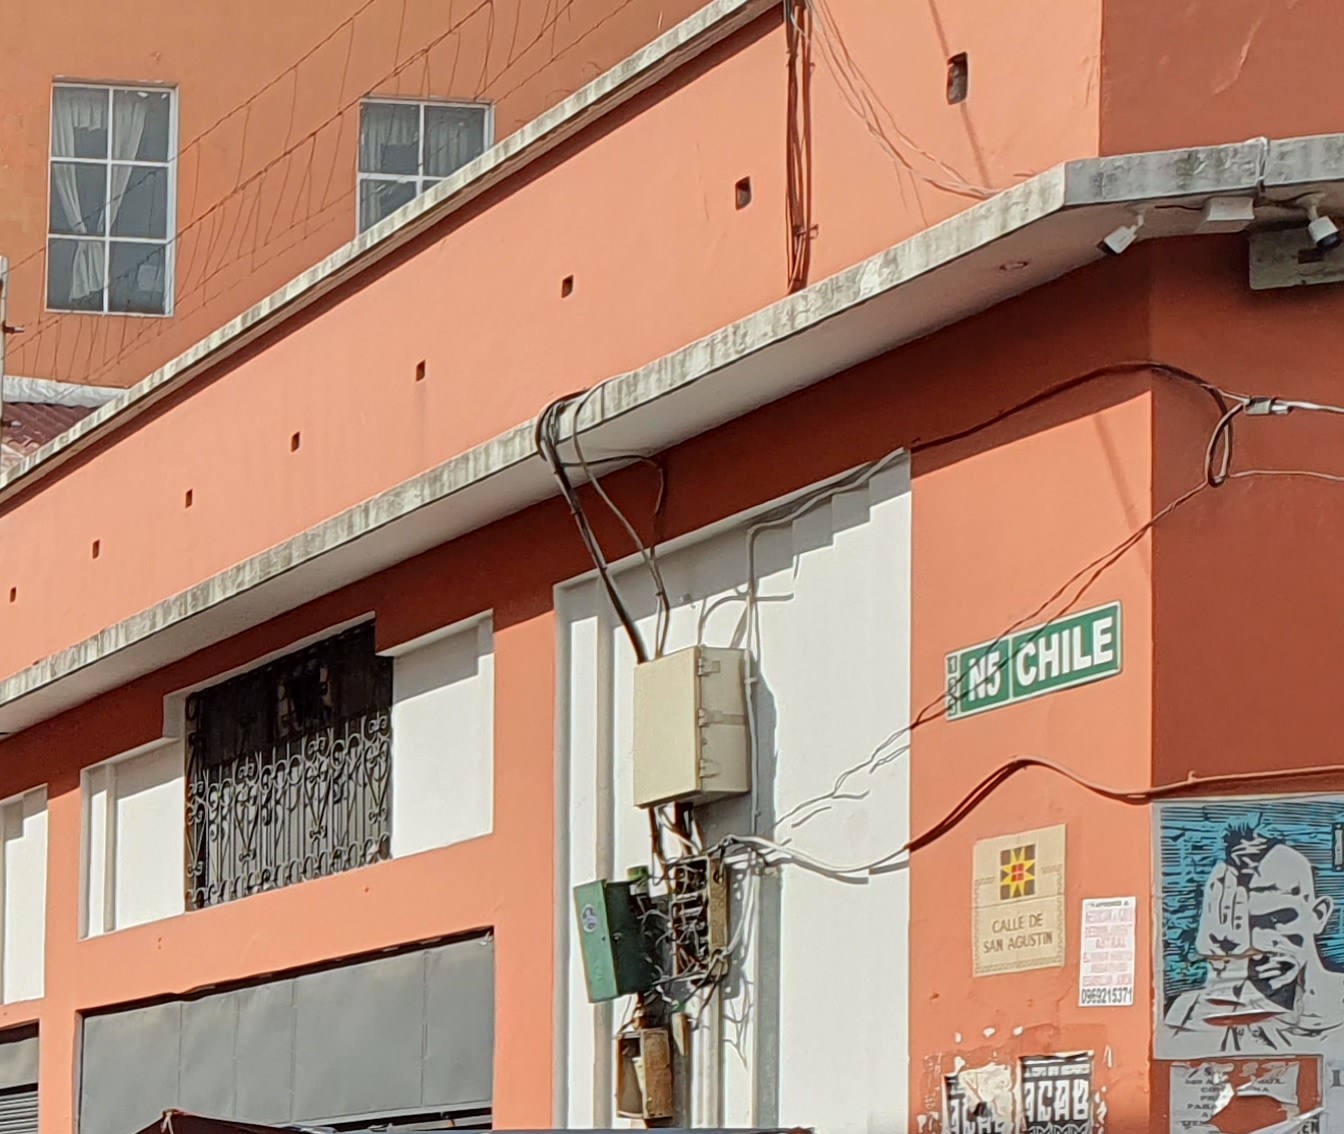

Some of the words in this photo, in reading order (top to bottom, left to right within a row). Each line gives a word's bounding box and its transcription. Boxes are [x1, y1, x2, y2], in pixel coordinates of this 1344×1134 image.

[968, 651, 1001, 701] N5
[1016, 616, 1113, 687] CHILE
[992, 915, 1025, 934] CALLE
[1029, 913, 1043, 928] DE
[983, 940, 1003, 954] SAN
[1008, 931, 1053, 950] AGUSTIN
